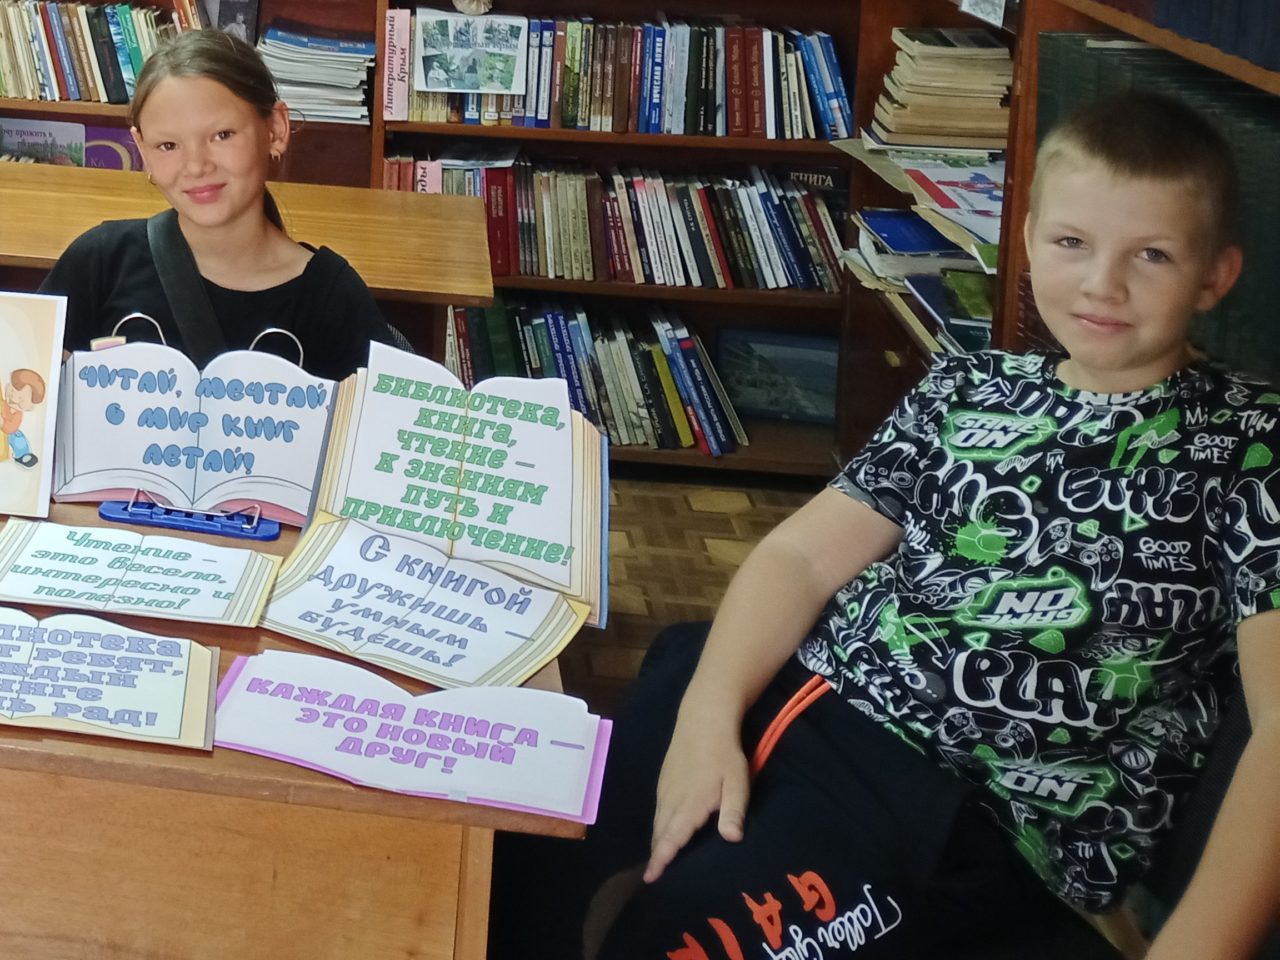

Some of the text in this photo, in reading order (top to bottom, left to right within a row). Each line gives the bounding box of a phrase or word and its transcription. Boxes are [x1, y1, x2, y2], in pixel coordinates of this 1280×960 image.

[384, 14, 397, 115] Литературный
[397, 47, 408, 83] Крым
[789, 172, 834, 188] КНИГА
[954, 412, 1042, 433] GAME
[947, 428, 1019, 448] ON
[1193, 433, 1239, 448] GOOD
[1184, 446, 1233, 464] TIMES
[66, 530, 193, 562] Чтение
[359, 534, 392, 563] С
[1138, 537, 1192, 554] GOOD
[30, 549, 227, 583] это весело,
[1132, 551, 1198, 572] TIMES
[10, 563, 201, 597] интересно
[33, 584, 190, 611] полезно!
[245, 677, 540, 748] КАЖДАЯ КНИГА
[295, 707, 517, 766] ЭТО НОВЫЙ
[334, 736, 459, 775] ДРУГ!
[999, 772, 1079, 803] ON
